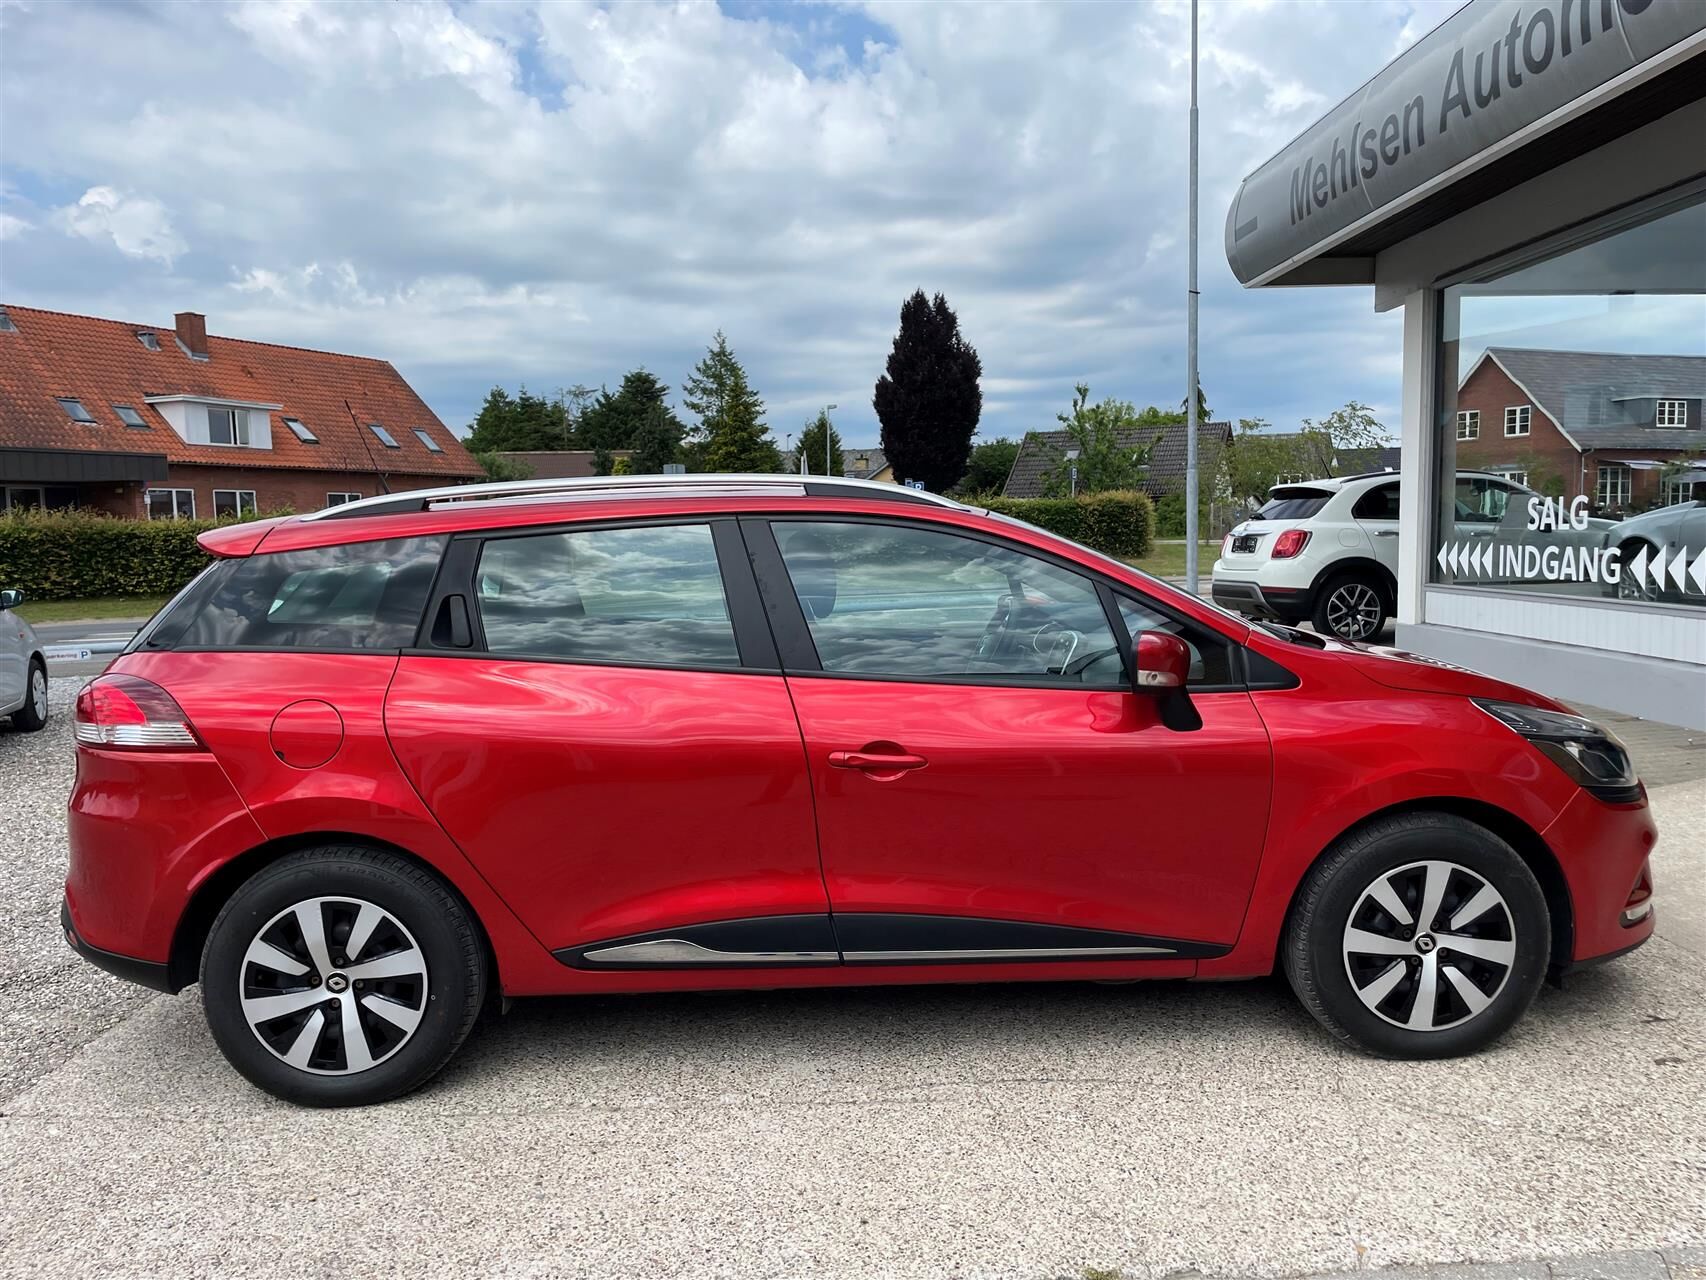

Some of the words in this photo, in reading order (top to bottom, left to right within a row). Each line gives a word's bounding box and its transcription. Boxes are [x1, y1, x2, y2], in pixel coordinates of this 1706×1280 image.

[1290, 93, 1425, 226] Mehlsen
[1439, 0, 1653, 134] Autom
[1527, 494, 1589, 531] SALG
[1498, 544, 1622, 585] INDGANG
